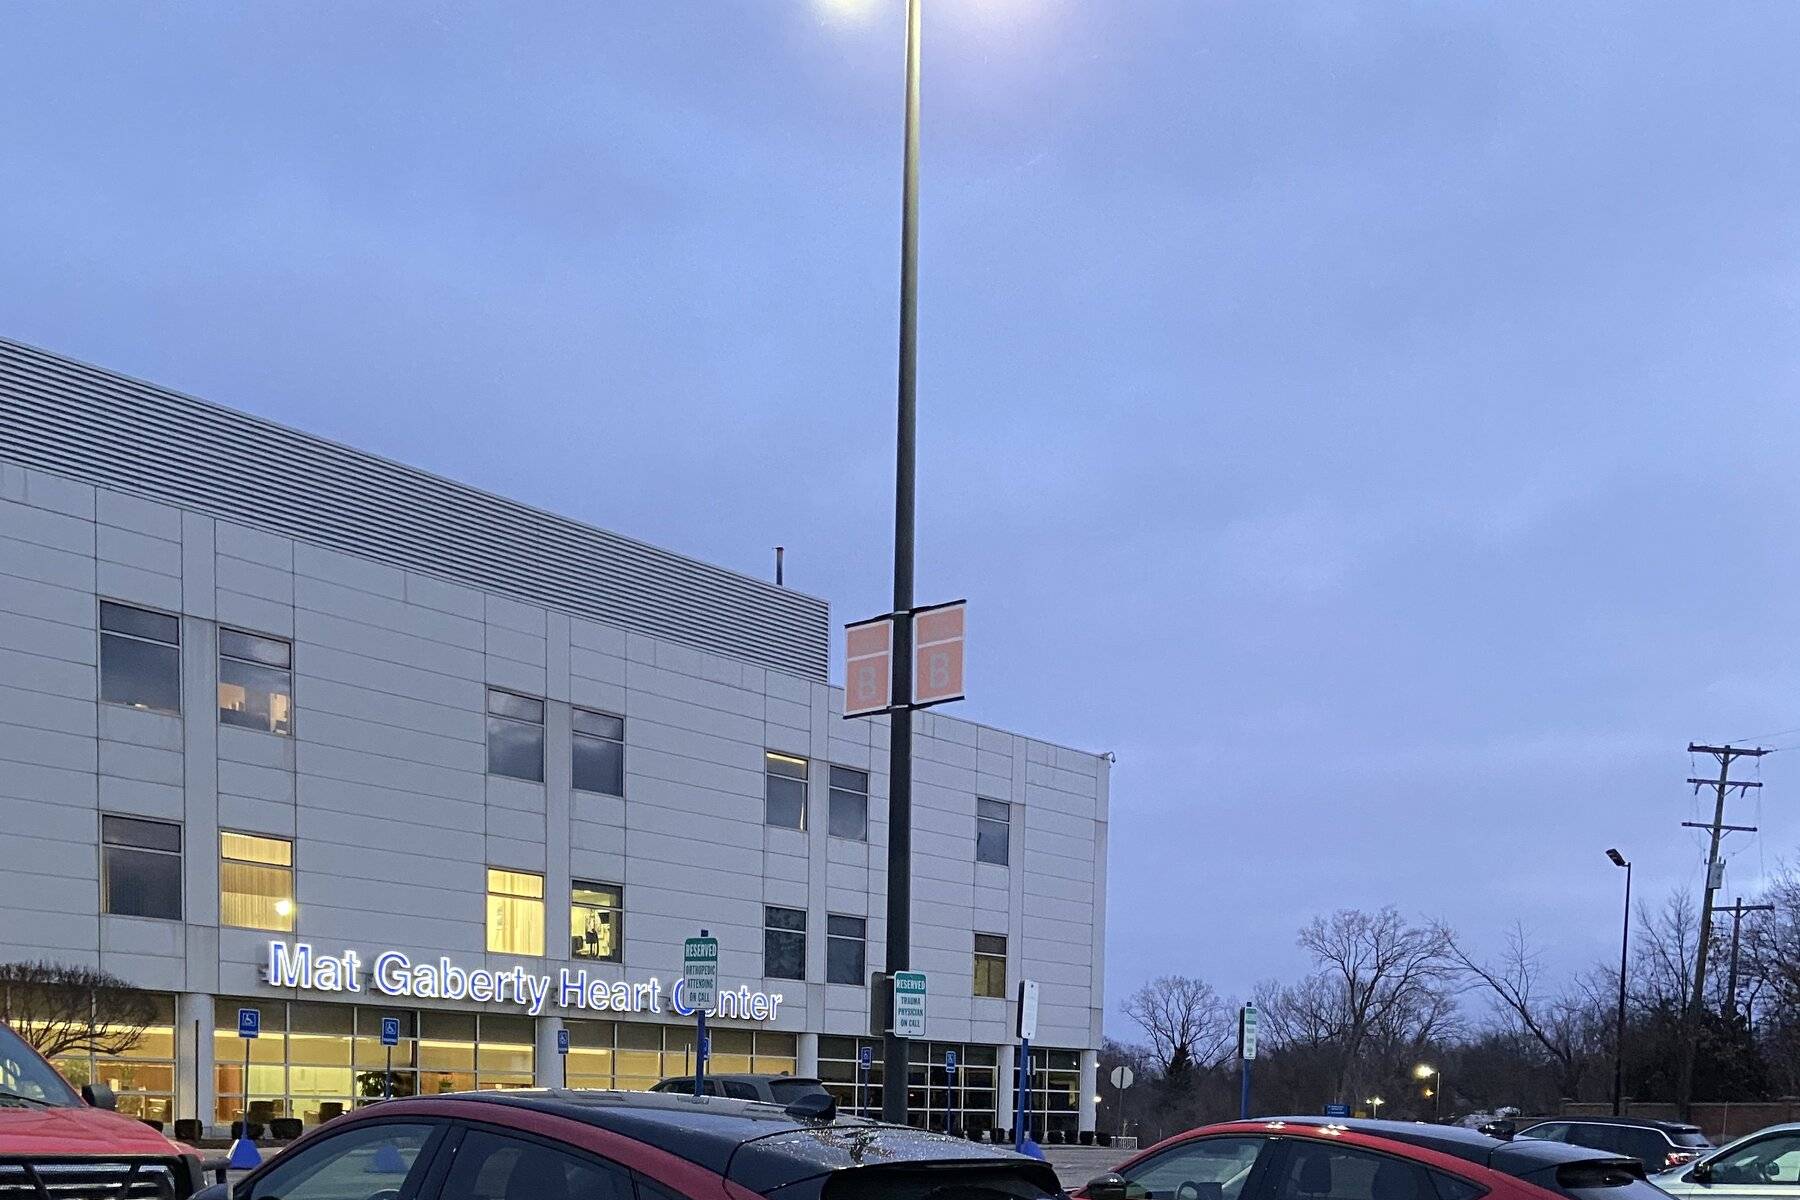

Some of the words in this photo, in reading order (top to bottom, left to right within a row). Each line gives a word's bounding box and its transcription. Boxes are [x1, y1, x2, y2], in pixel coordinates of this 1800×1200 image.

[686, 943, 717, 957] RESERVED
[686, 965, 716, 976] ORTHOPEDIC
[269, 941, 361, 992] Mat
[374, 951, 551, 1016] Gaberty
[560, 968, 661, 1014] Heart
[673, 977, 783, 1020] Cnter
[687, 978, 714, 989] ATTENDING
[897, 979, 926, 990] RESERVED
[689, 992, 697, 1001] ON
[698, 992, 710, 1002] CALL
[901, 996, 921, 1005] TRAUMA
[898, 1007, 924, 1017] PHYSICIAN
[901, 1018, 908, 1027] ON
[909, 1019, 921, 1028] CALL
